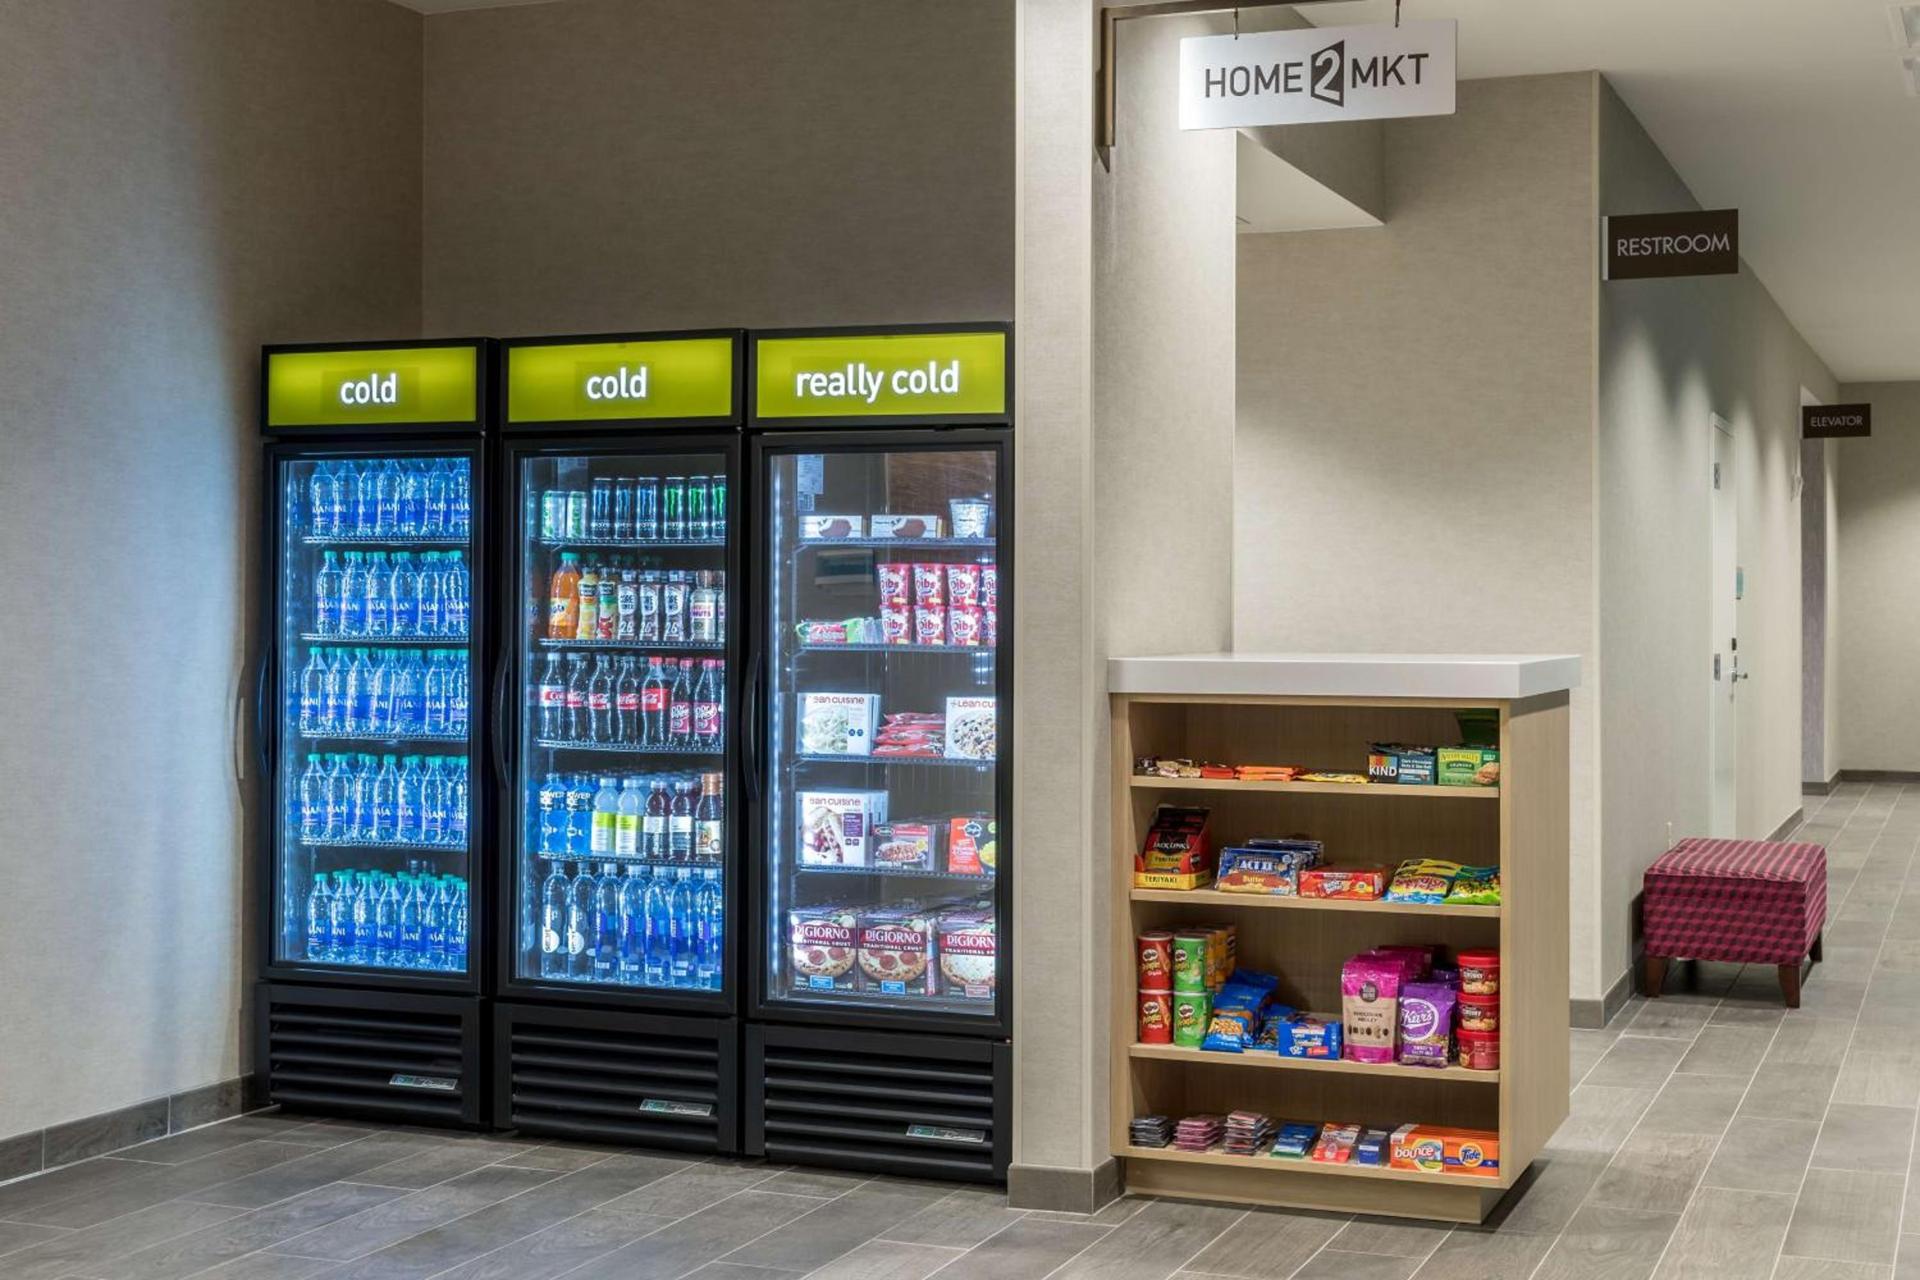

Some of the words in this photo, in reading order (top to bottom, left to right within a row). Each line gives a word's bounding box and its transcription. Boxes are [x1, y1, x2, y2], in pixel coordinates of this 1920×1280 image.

[1616, 233, 1730, 257] RESTROOM
[340, 372, 397, 405] cold
[586, 366, 647, 400] cold
[796, 362, 885, 404] really
[891, 360, 960, 395] cold
[1810, 415, 1863, 428] ELEVATOR
[1369, 766, 1397, 777] KIND
[864, 929, 921, 944] DIGIORNO
[946, 934, 995, 948] DIGIORN
[1394, 1146, 1434, 1159] bounce
[1460, 1148, 1481, 1161] Tide
